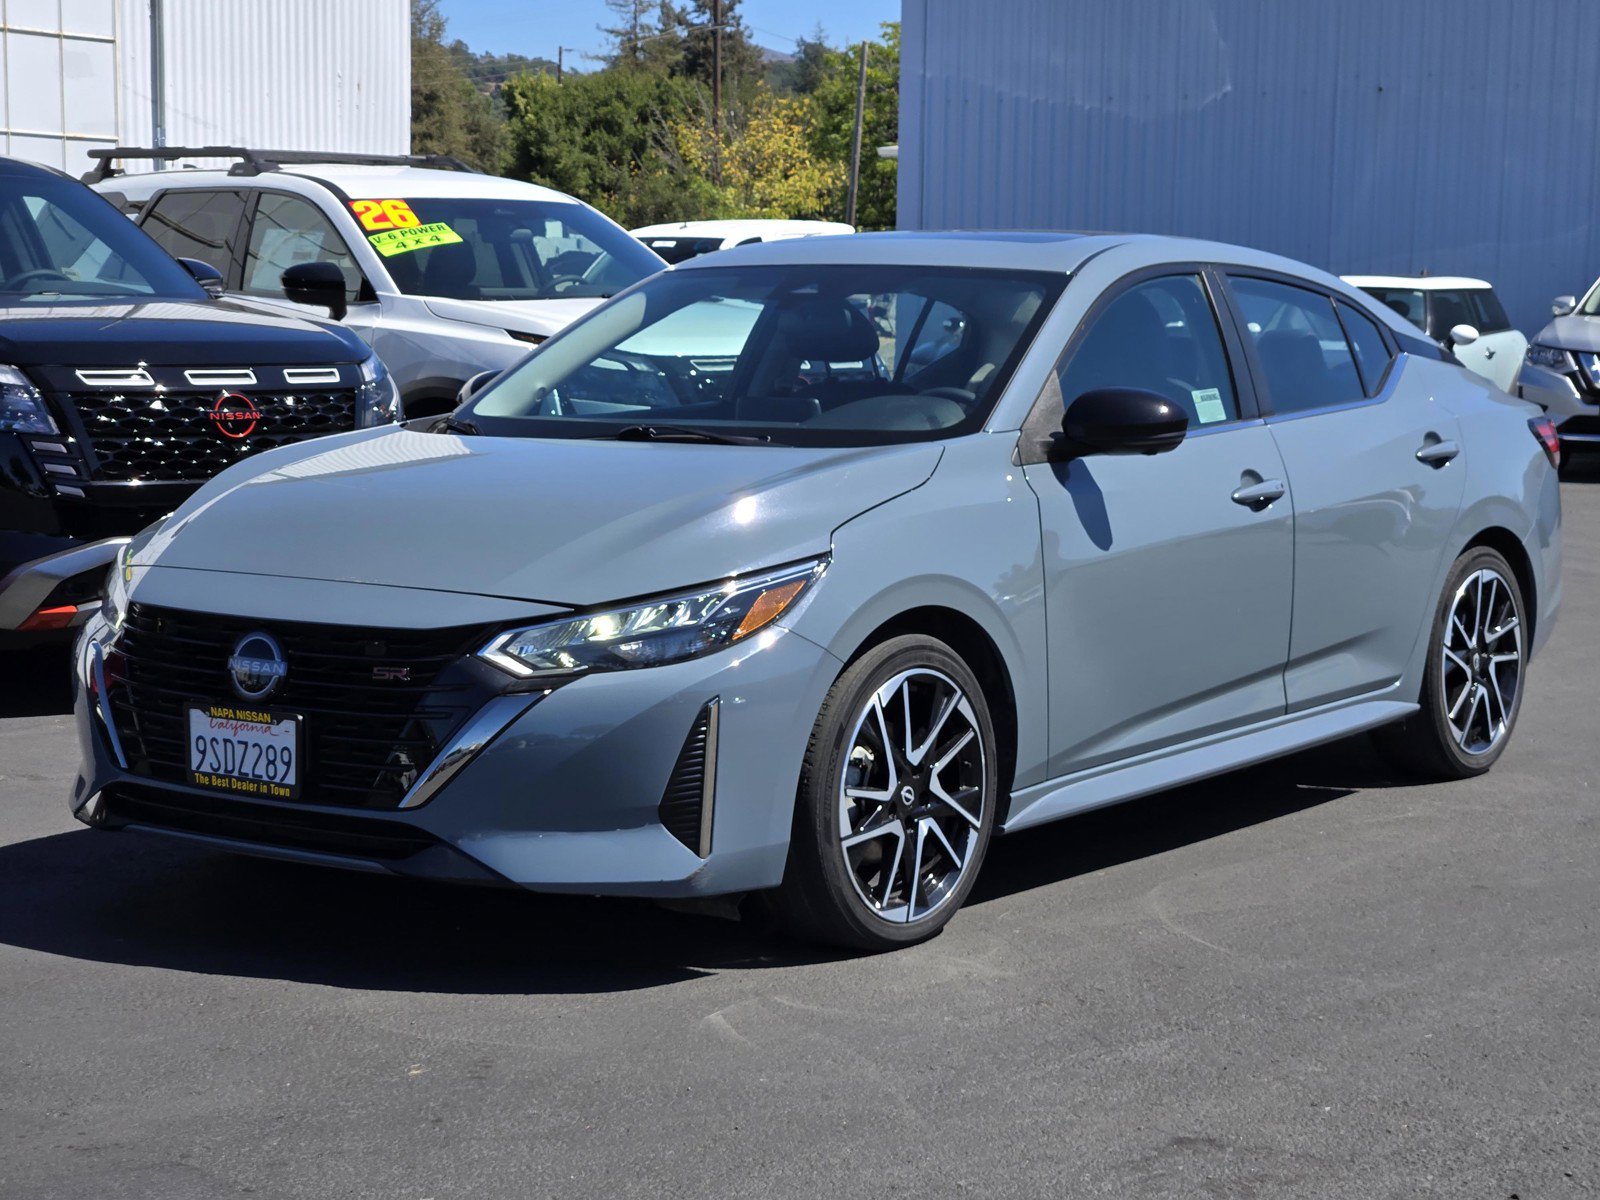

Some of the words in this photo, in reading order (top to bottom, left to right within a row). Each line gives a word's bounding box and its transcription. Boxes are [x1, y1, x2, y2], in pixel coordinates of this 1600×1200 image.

[352, 200, 421, 230] 26
[401, 225, 446, 238] POWER
[209, 411, 261, 420] NISSAN
[228, 658, 285, 674] NISSAN
[372, 667, 410, 680] SR
[210, 706, 235, 719] NAPA
[236, 709, 271, 723] NISSAN
[209, 717, 280, 737] California
[195, 735, 292, 783] 9SDZ289
[194, 773, 209, 785] The
[211, 775, 229, 788] Best
[231, 778, 258, 792] Dealer
[260, 782, 267, 793] in
[270, 784, 290, 797] Town
